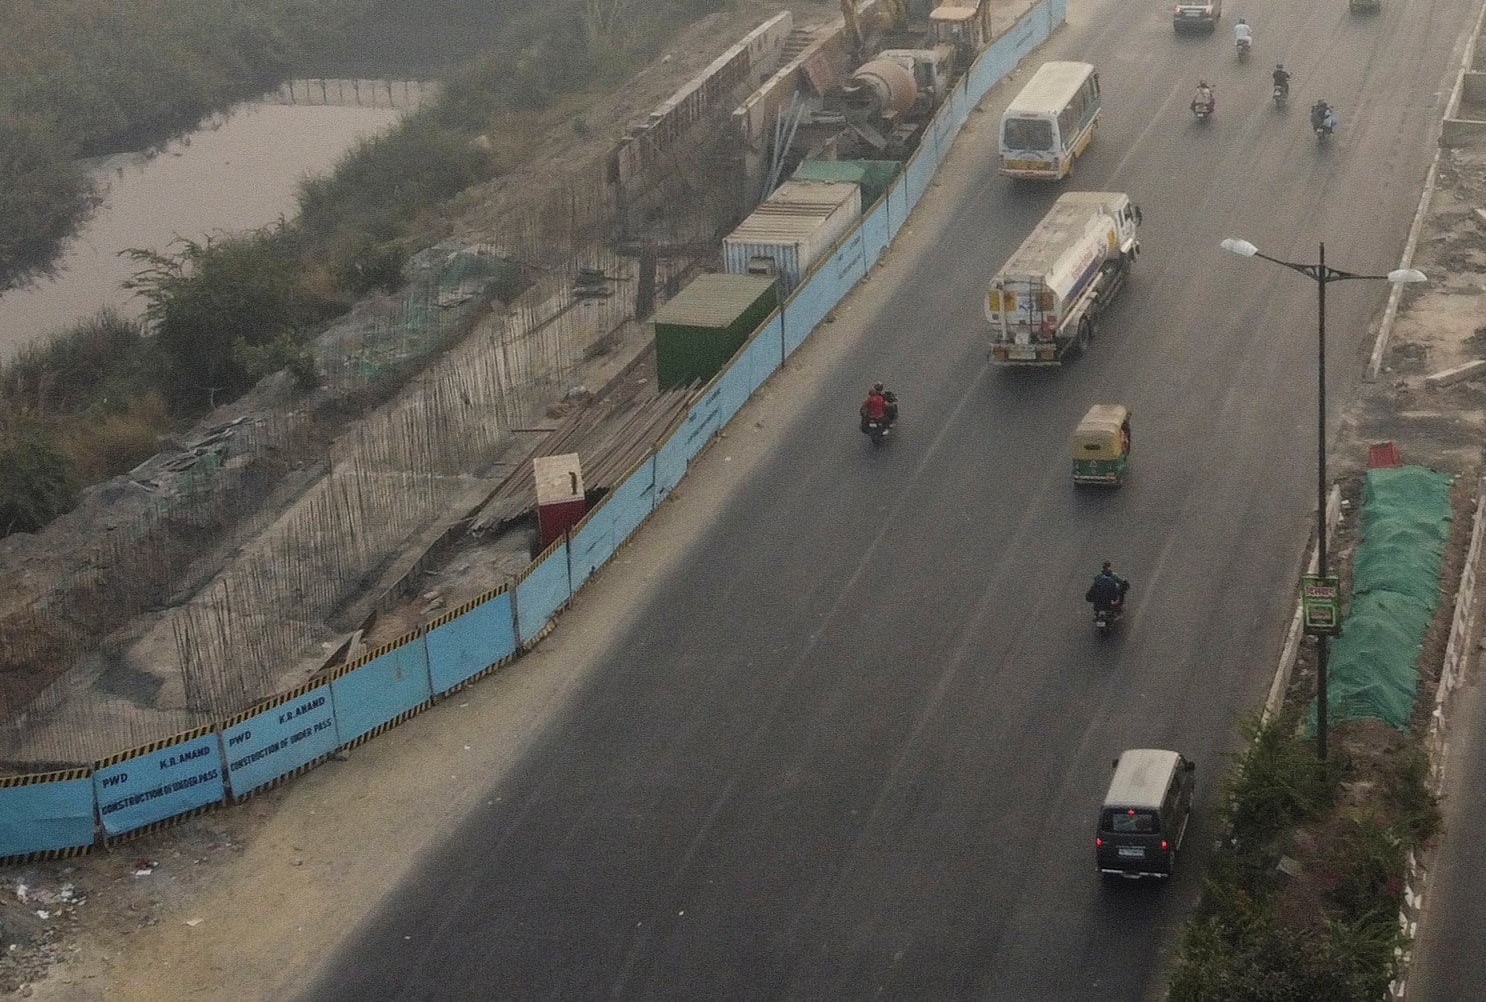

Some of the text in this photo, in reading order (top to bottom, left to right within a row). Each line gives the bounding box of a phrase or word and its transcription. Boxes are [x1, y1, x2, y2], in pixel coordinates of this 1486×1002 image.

[229, 730, 252, 747] PWD
[230, 718, 332, 772] CONSTRUCTION OF UNDER PASS
[101, 785, 163, 816] CONSTRUCTION
[173, 776, 199, 792] UNDER
[199, 769, 219, 784] PASS
[102, 773, 128, 789] PWD
